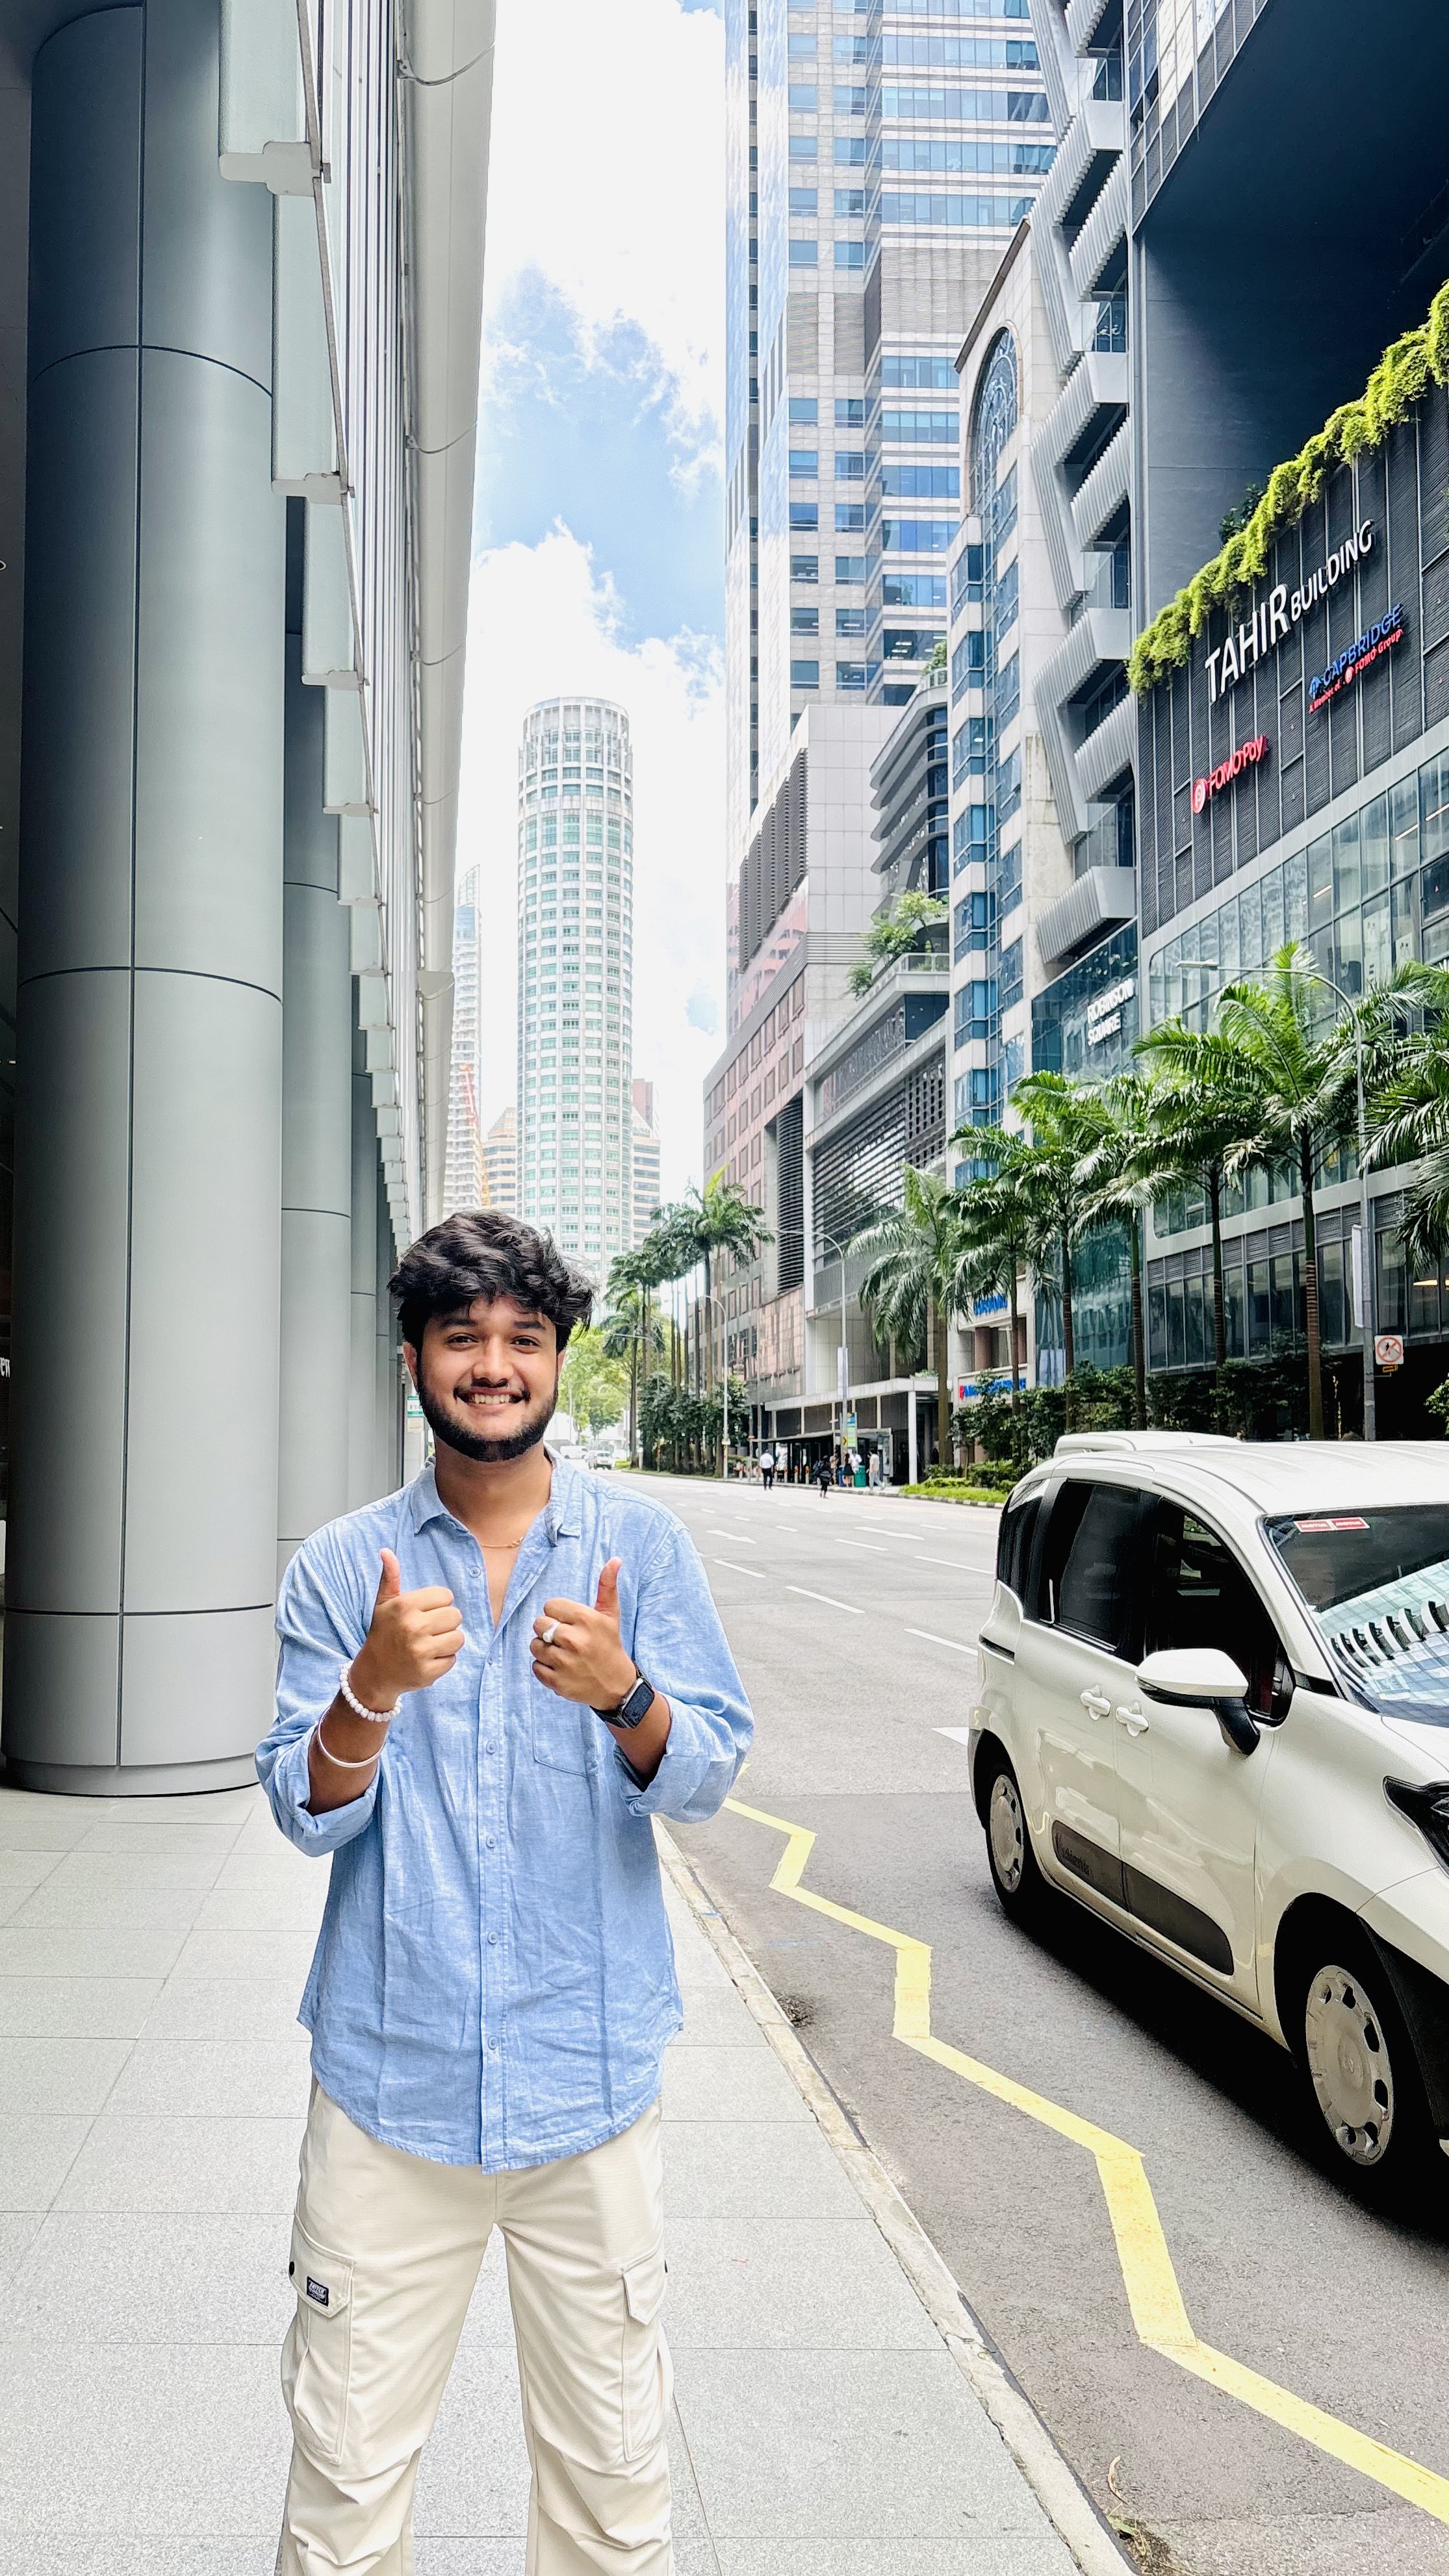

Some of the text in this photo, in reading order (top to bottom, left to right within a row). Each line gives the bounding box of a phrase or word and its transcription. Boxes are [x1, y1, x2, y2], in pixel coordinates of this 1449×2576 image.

[1205, 520, 1372, 702] TAHIR BUILDING
[1322, 603, 1404, 686] CAPBRIDGE
[1355, 647, 1378, 674] FOMO
[1378, 628, 1404, 654] Group
[1087, 978, 1135, 1024] ROBINSON
[1088, 1012, 1122, 1046] SQUARE
